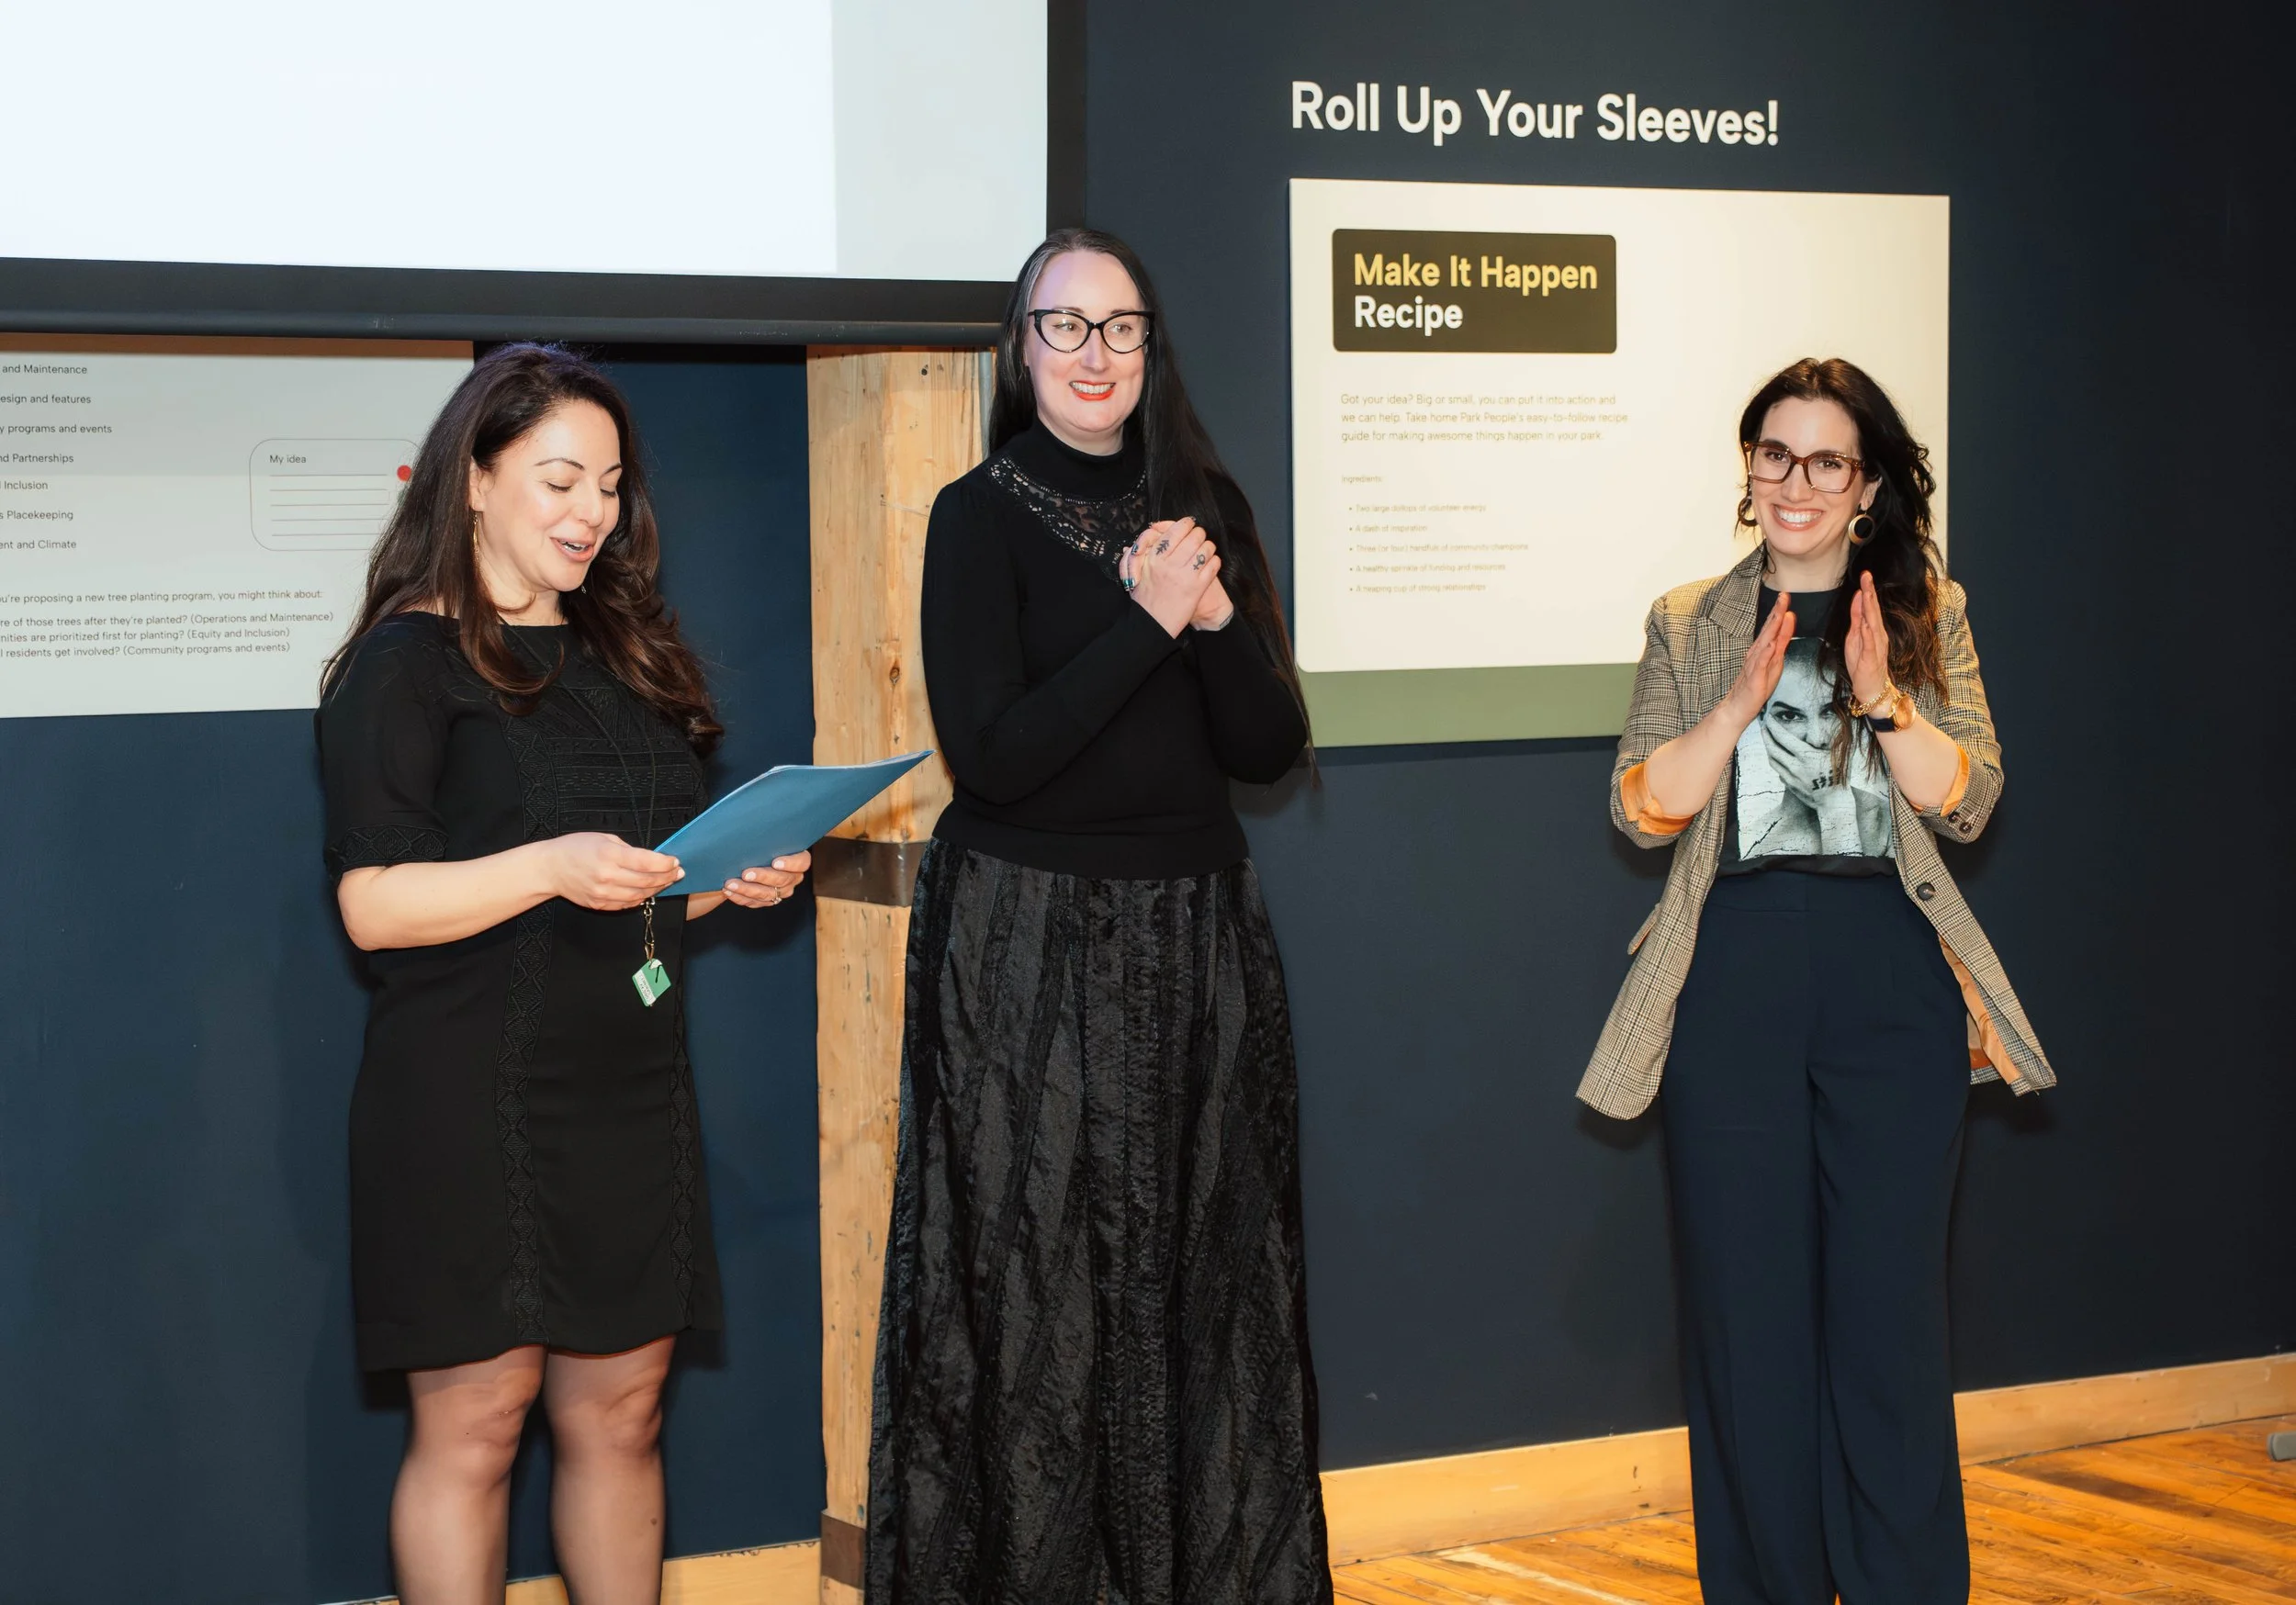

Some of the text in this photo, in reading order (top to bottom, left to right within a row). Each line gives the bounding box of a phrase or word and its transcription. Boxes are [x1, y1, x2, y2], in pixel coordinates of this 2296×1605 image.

[1292, 81, 1779, 147] Roll Up Your Sleeves!
[1355, 253, 1598, 297] Make It Happen
[1355, 295, 1464, 336] Recipe
[2, 364, 88, 375] and Maintenance
[0, 393, 92, 405] esign and features
[1341, 393, 1358, 405] Got
[1363, 395, 1384, 406] your
[1387, 393, 1413, 405] idea?
[1416, 393, 1433, 406] Big
[1435, 396, 1445, 405] or
[1479, 396, 1495, 406] you
[1499, 396, 1515, 405] can
[1518, 395, 1534, 407] put
[1536, 395, 1543, 405] it
[1547, 395, 1564, 405] into
[1567, 395, 1595, 405] action
[1598, 394, 1616, 405] and
[1341, 413, 1356, 422] we
[1358, 413, 1376, 422] can
[1405, 411, 1427, 422] Take
[1430, 411, 1458, 422] home
[1460, 411, 1480, 422] Park
[1484, 411, 1524, 424] People's
[1526, 411, 1595, 424] easy-to-follow
[1598, 412, 1628, 424] recipe
[7, 425, 56, 435] programs
[59, 424, 77, 433] and
[80, 425, 112, 433] events
[1341, 431, 1369, 443] guide
[1372, 430, 1386, 441] for
[1389, 431, 1424, 443] making
[1427, 432, 1473, 441] awesome
[1476, 430, 1505, 443] things
[1508, 431, 1543, 443] happen
[1546, 431, 1555, 441] in
[1558, 432, 1578, 443] your
[12, 453, 74, 465] Partnerships
[269, 455, 307, 466] My idea
[4, 480, 49, 490] Inclusion
[6, 510, 73, 521] Placekeeping
[0, 539, 77, 550] ent and Climate
[23, 592, 73, 605] proposing
[84, 594, 105, 602] new
[107, 593, 128, 601] tree
[129, 592, 169, 604] planting
[172, 592, 215, 603] program,
[218, 592, 236, 602] you
[238, 590, 265, 601] might
[268, 589, 291, 600] think
[293, 589, 322, 599] about:
[0, 611, 333, 628] re of those trees after they're planted? (Operations and Maintenance)
[0, 626, 290, 644] nities are prioritized first for planting? (Equity and Inclusion)
[6, 646, 51, 657] residents
[54, 647, 71, 659] get
[73, 645, 120, 657] involved?
[123, 644, 184, 656] (Community
[186, 644, 232, 656] programs
[235, 643, 253, 653] and
[255, 641, 290, 653] events)
